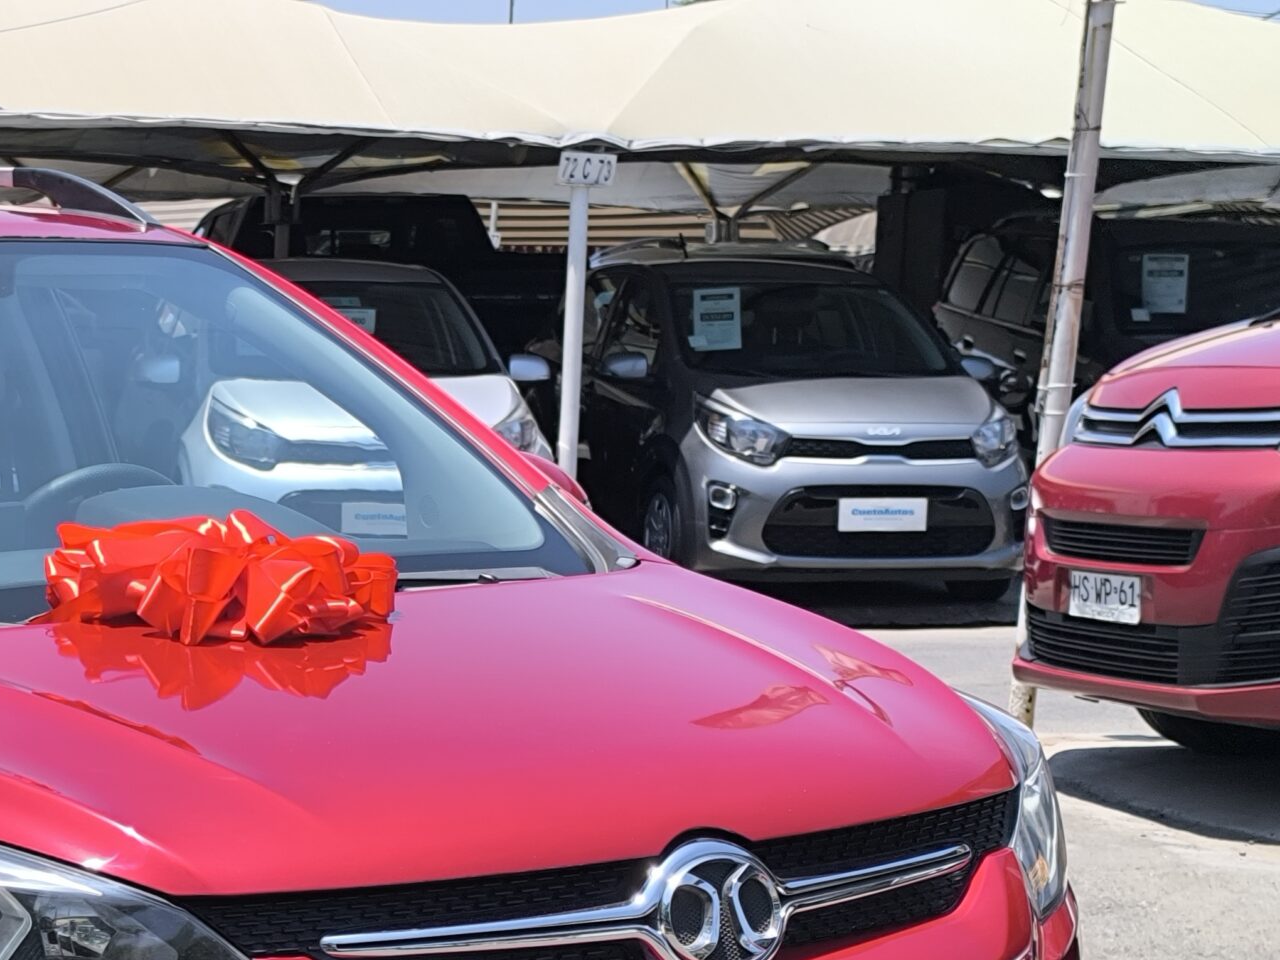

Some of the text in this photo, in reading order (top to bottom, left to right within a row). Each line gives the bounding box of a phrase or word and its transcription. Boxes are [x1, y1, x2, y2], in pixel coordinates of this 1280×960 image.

[561, 156, 613, 184] 72 C 73
